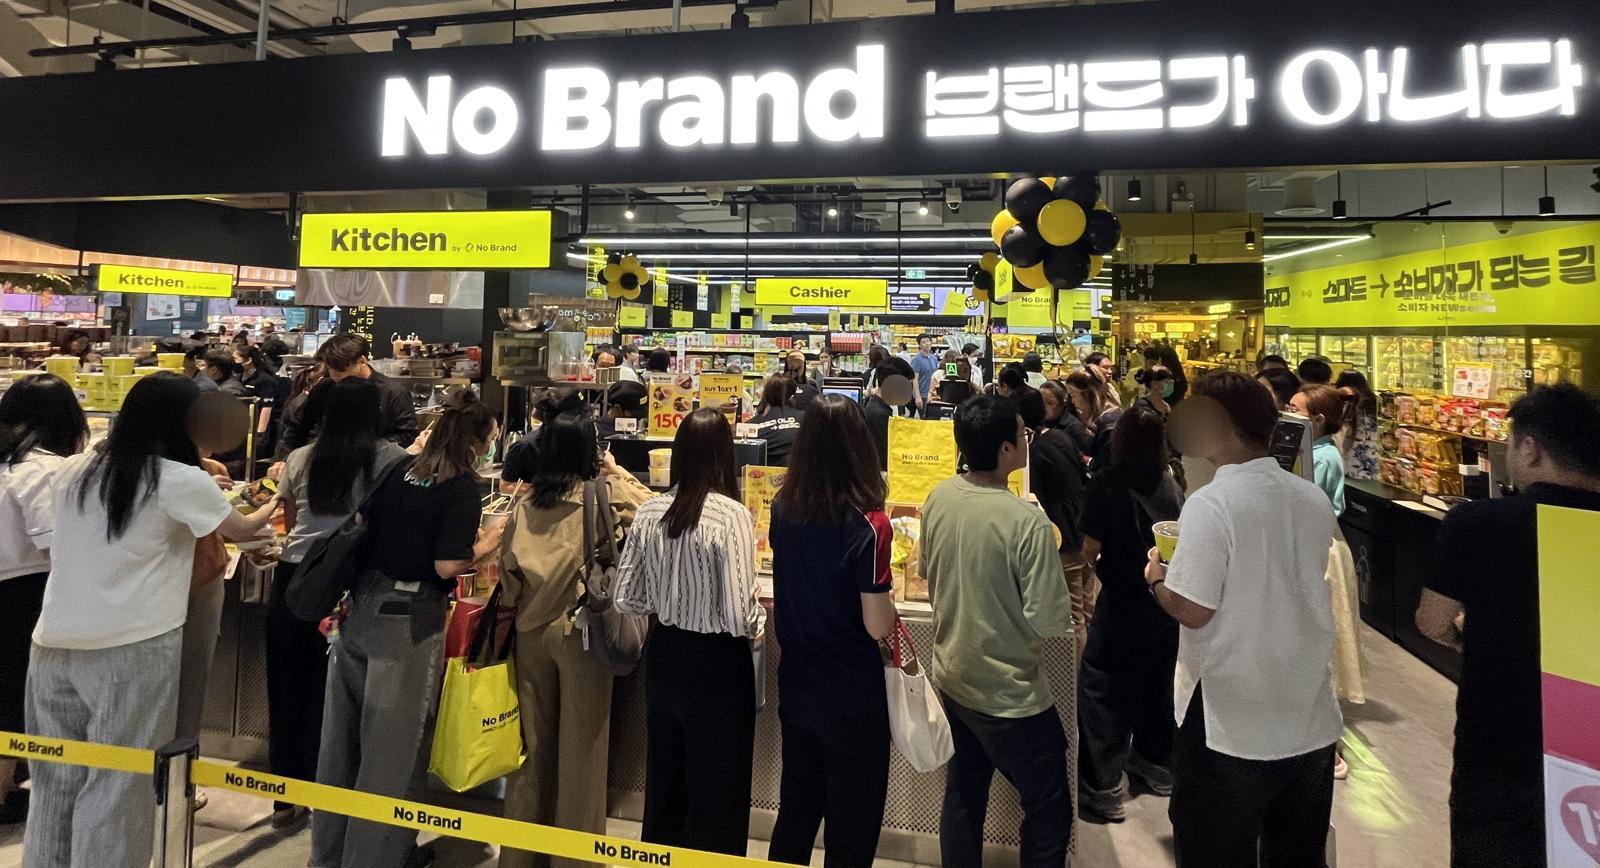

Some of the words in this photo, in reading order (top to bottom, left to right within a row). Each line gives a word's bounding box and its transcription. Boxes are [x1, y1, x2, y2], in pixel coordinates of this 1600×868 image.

[925, 55, 1255, 137] 브랜드가
[1282, 38, 1583, 125] 아니다
[381, 75, 518, 156] No
[541, 44, 885, 150] Brand
[331, 228, 447, 252] Kitchen
[476, 244, 489, 252] No
[490, 244, 517, 252] Brand
[1559, 245, 1596, 284] 길
[118, 273, 184, 288] Kitchen
[789, 286, 851, 298] Cashier
[482, 717, 496, 727] No
[9, 738, 25, 751] No
[28, 741, 64, 756] Brand
[225, 773, 243, 786] No
[246, 776, 285, 795] Brand
[394, 806, 414, 821] No
[417, 811, 462, 830] Brand
[1567, 803, 1600, 845] 1
[594, 841, 617, 857] No
[621, 845, 671, 866] Brand
